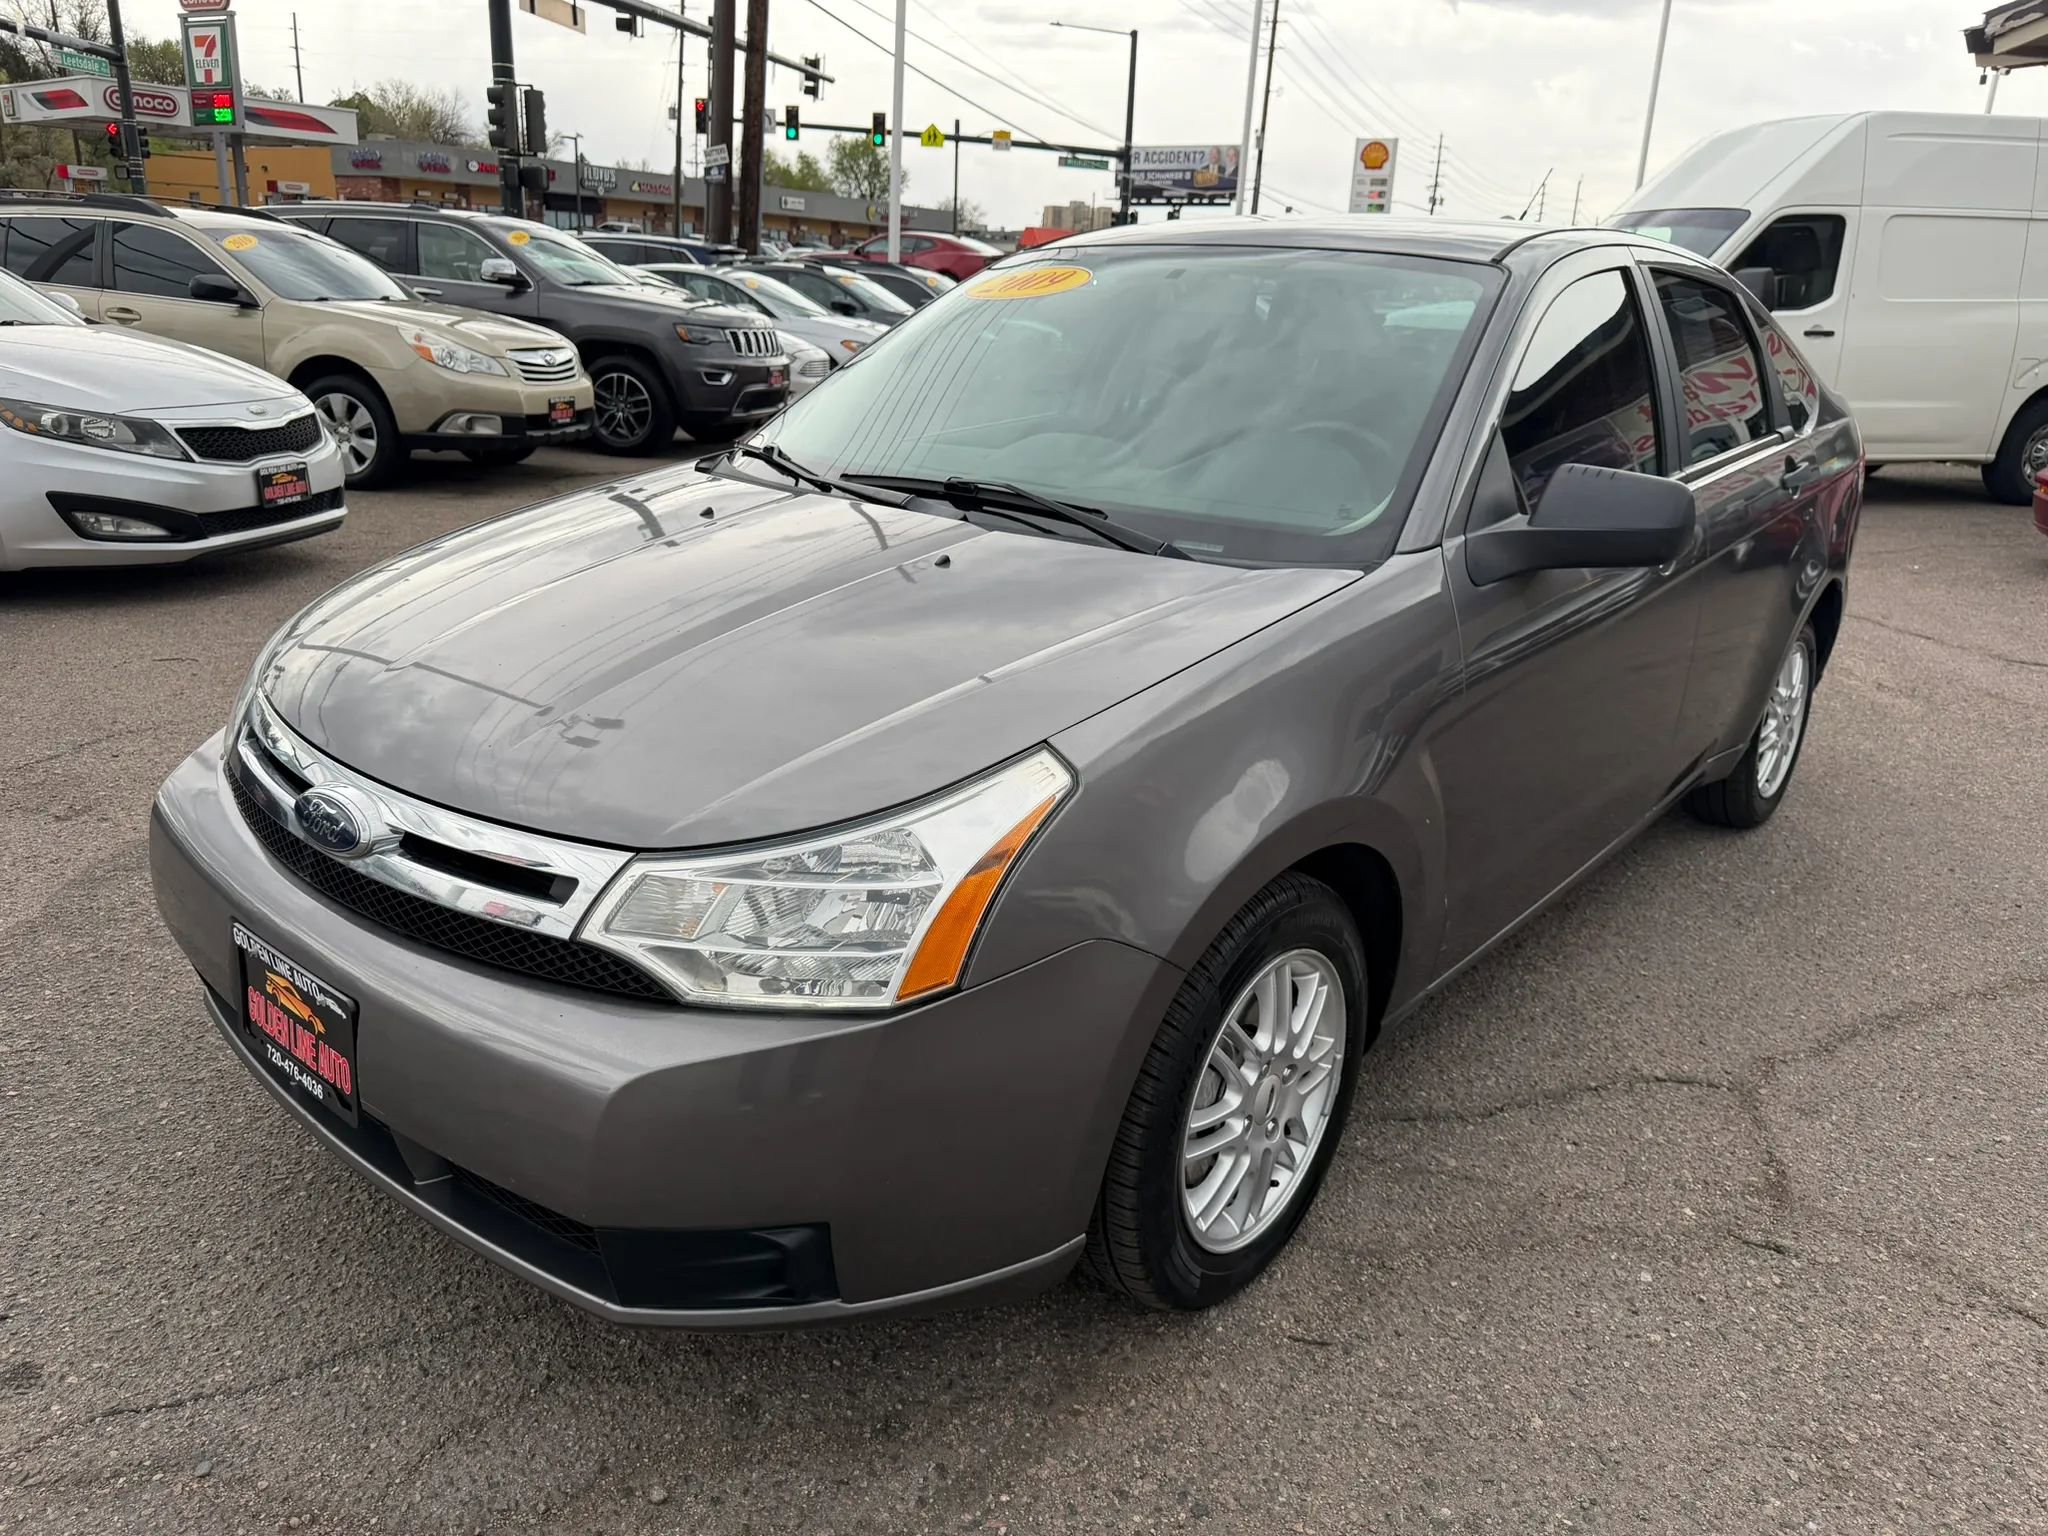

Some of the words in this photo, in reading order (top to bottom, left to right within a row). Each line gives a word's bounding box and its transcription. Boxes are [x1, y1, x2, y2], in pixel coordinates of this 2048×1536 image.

[193, 33, 217, 83] 7
[1144, 150, 1205, 165] ACCIDENT?
[975, 270, 1078, 295] 2009
[302, 798, 346, 843] Ford
[233, 927, 271, 966] GOLDEN
[271, 956, 294, 983] LINE
[293, 969, 320, 998] AUTO
[247, 985, 290, 1050] GOLDEN
[290, 1020, 317, 1072] LINE
[318, 1039, 352, 1095] AUTO
[266, 1043, 324, 1100] 720-476-4036
